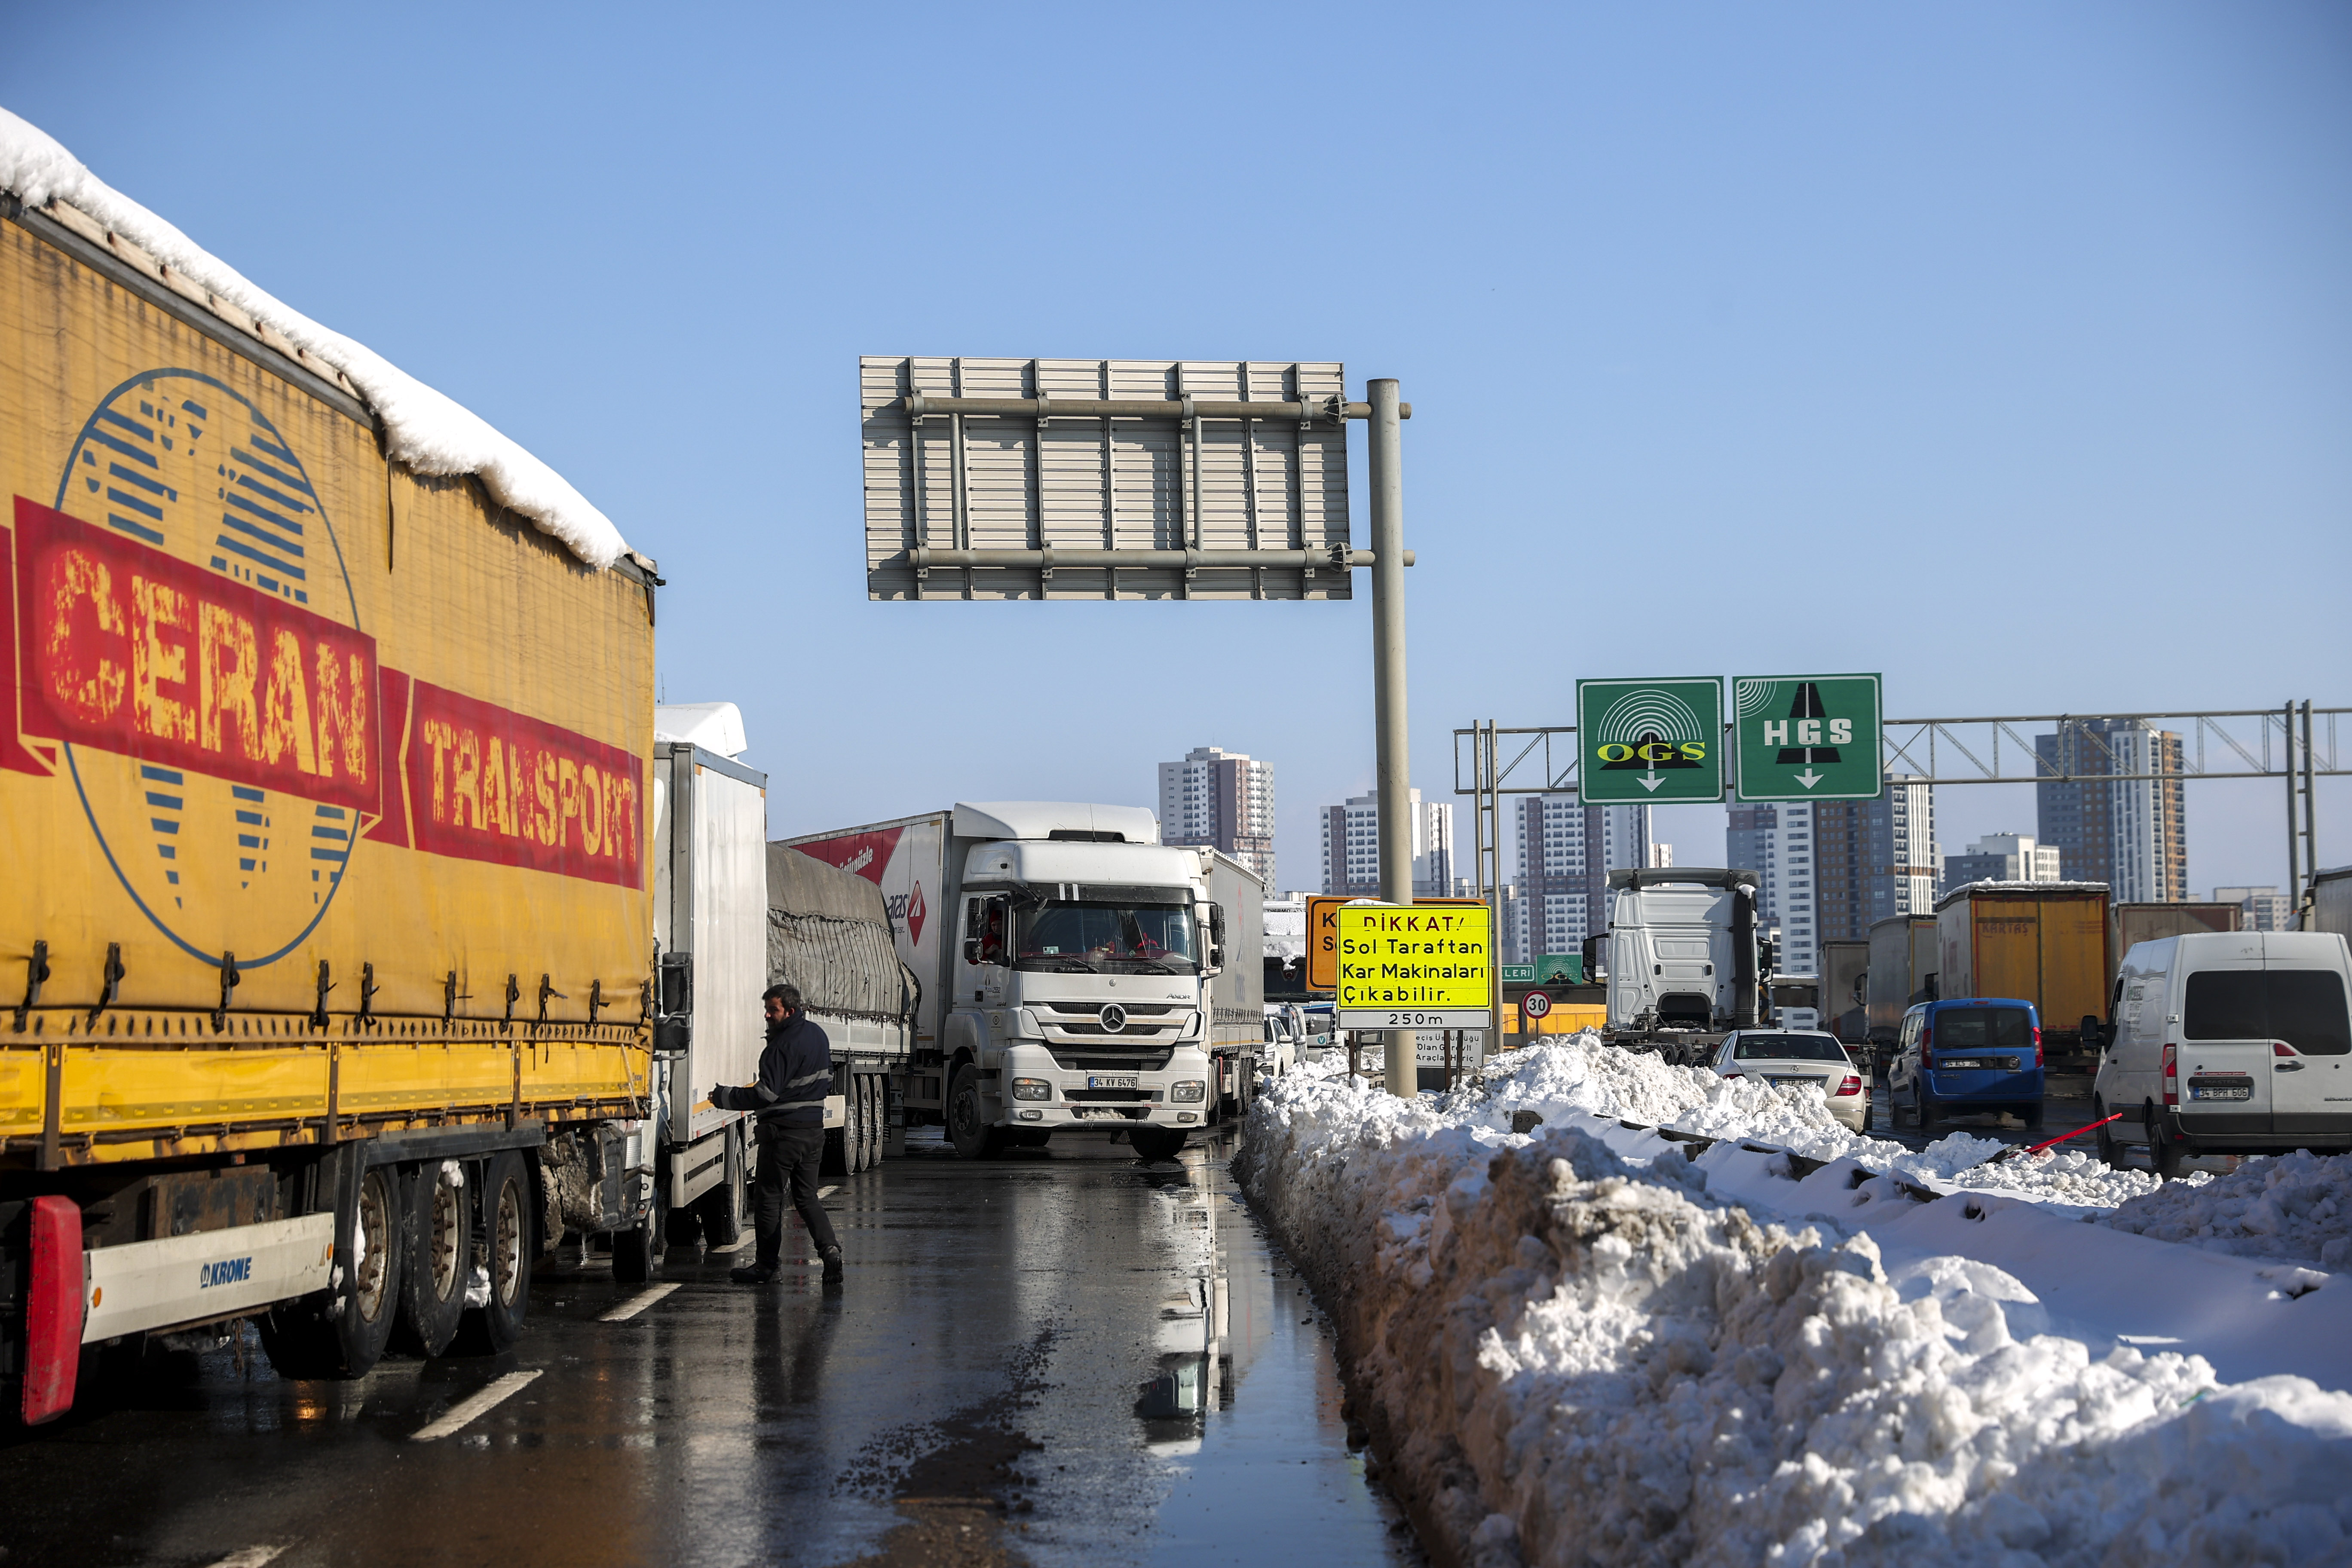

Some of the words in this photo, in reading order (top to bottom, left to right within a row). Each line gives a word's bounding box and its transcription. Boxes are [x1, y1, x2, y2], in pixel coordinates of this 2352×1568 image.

[46, 549, 366, 786] CERAN
[1764, 718, 1853, 746] HGS
[1597, 741, 1706, 762] OGS
[424, 718, 638, 862] TRANSPORT
[1364, 913, 1464, 931] DİKKAT!
[1982, 922, 2028, 936] KARTAŞ
[1343, 938, 1376, 954] Sol
[1387, 938, 1482, 954] Taraftan
[1342, 963, 1375, 979] Kar
[1382, 963, 1484, 979] Makinaları
[1344, 985, 1450, 1004] Çıkabilir.
[1529, 998, 1546, 1011] 30
[1451, 1054, 1473, 1063] Hriç
[1106, 1078, 1115, 1087] KV
[2200, 1088, 2210, 1096] 34
[2213, 1088, 2228, 1096] BPH
[2233, 1088, 2248, 1096] 606
[209, 1256, 252, 1287] KRONE
